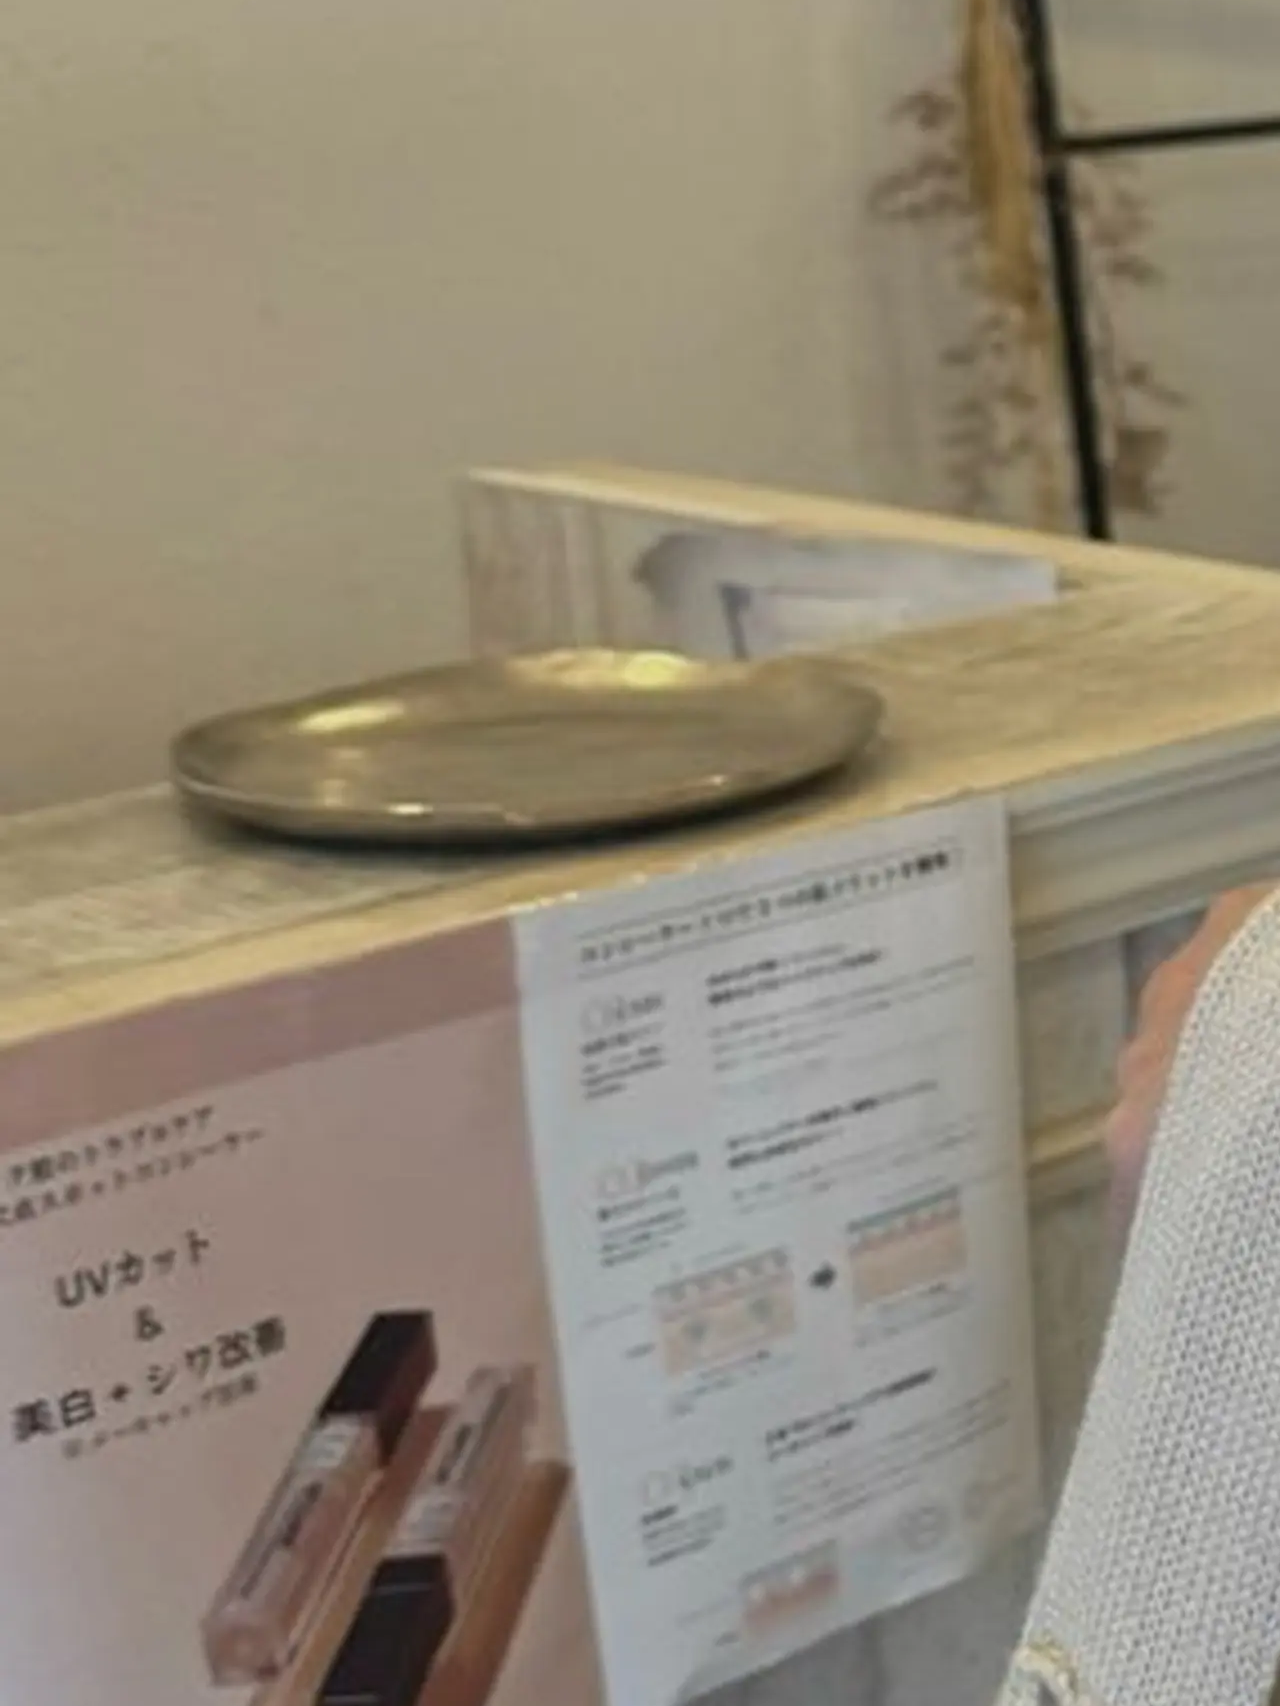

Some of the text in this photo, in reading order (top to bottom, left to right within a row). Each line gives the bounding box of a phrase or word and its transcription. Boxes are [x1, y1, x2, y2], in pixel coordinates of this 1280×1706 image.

[54, 1228, 211, 1309] UVカット
[134, 1304, 165, 1343] &
